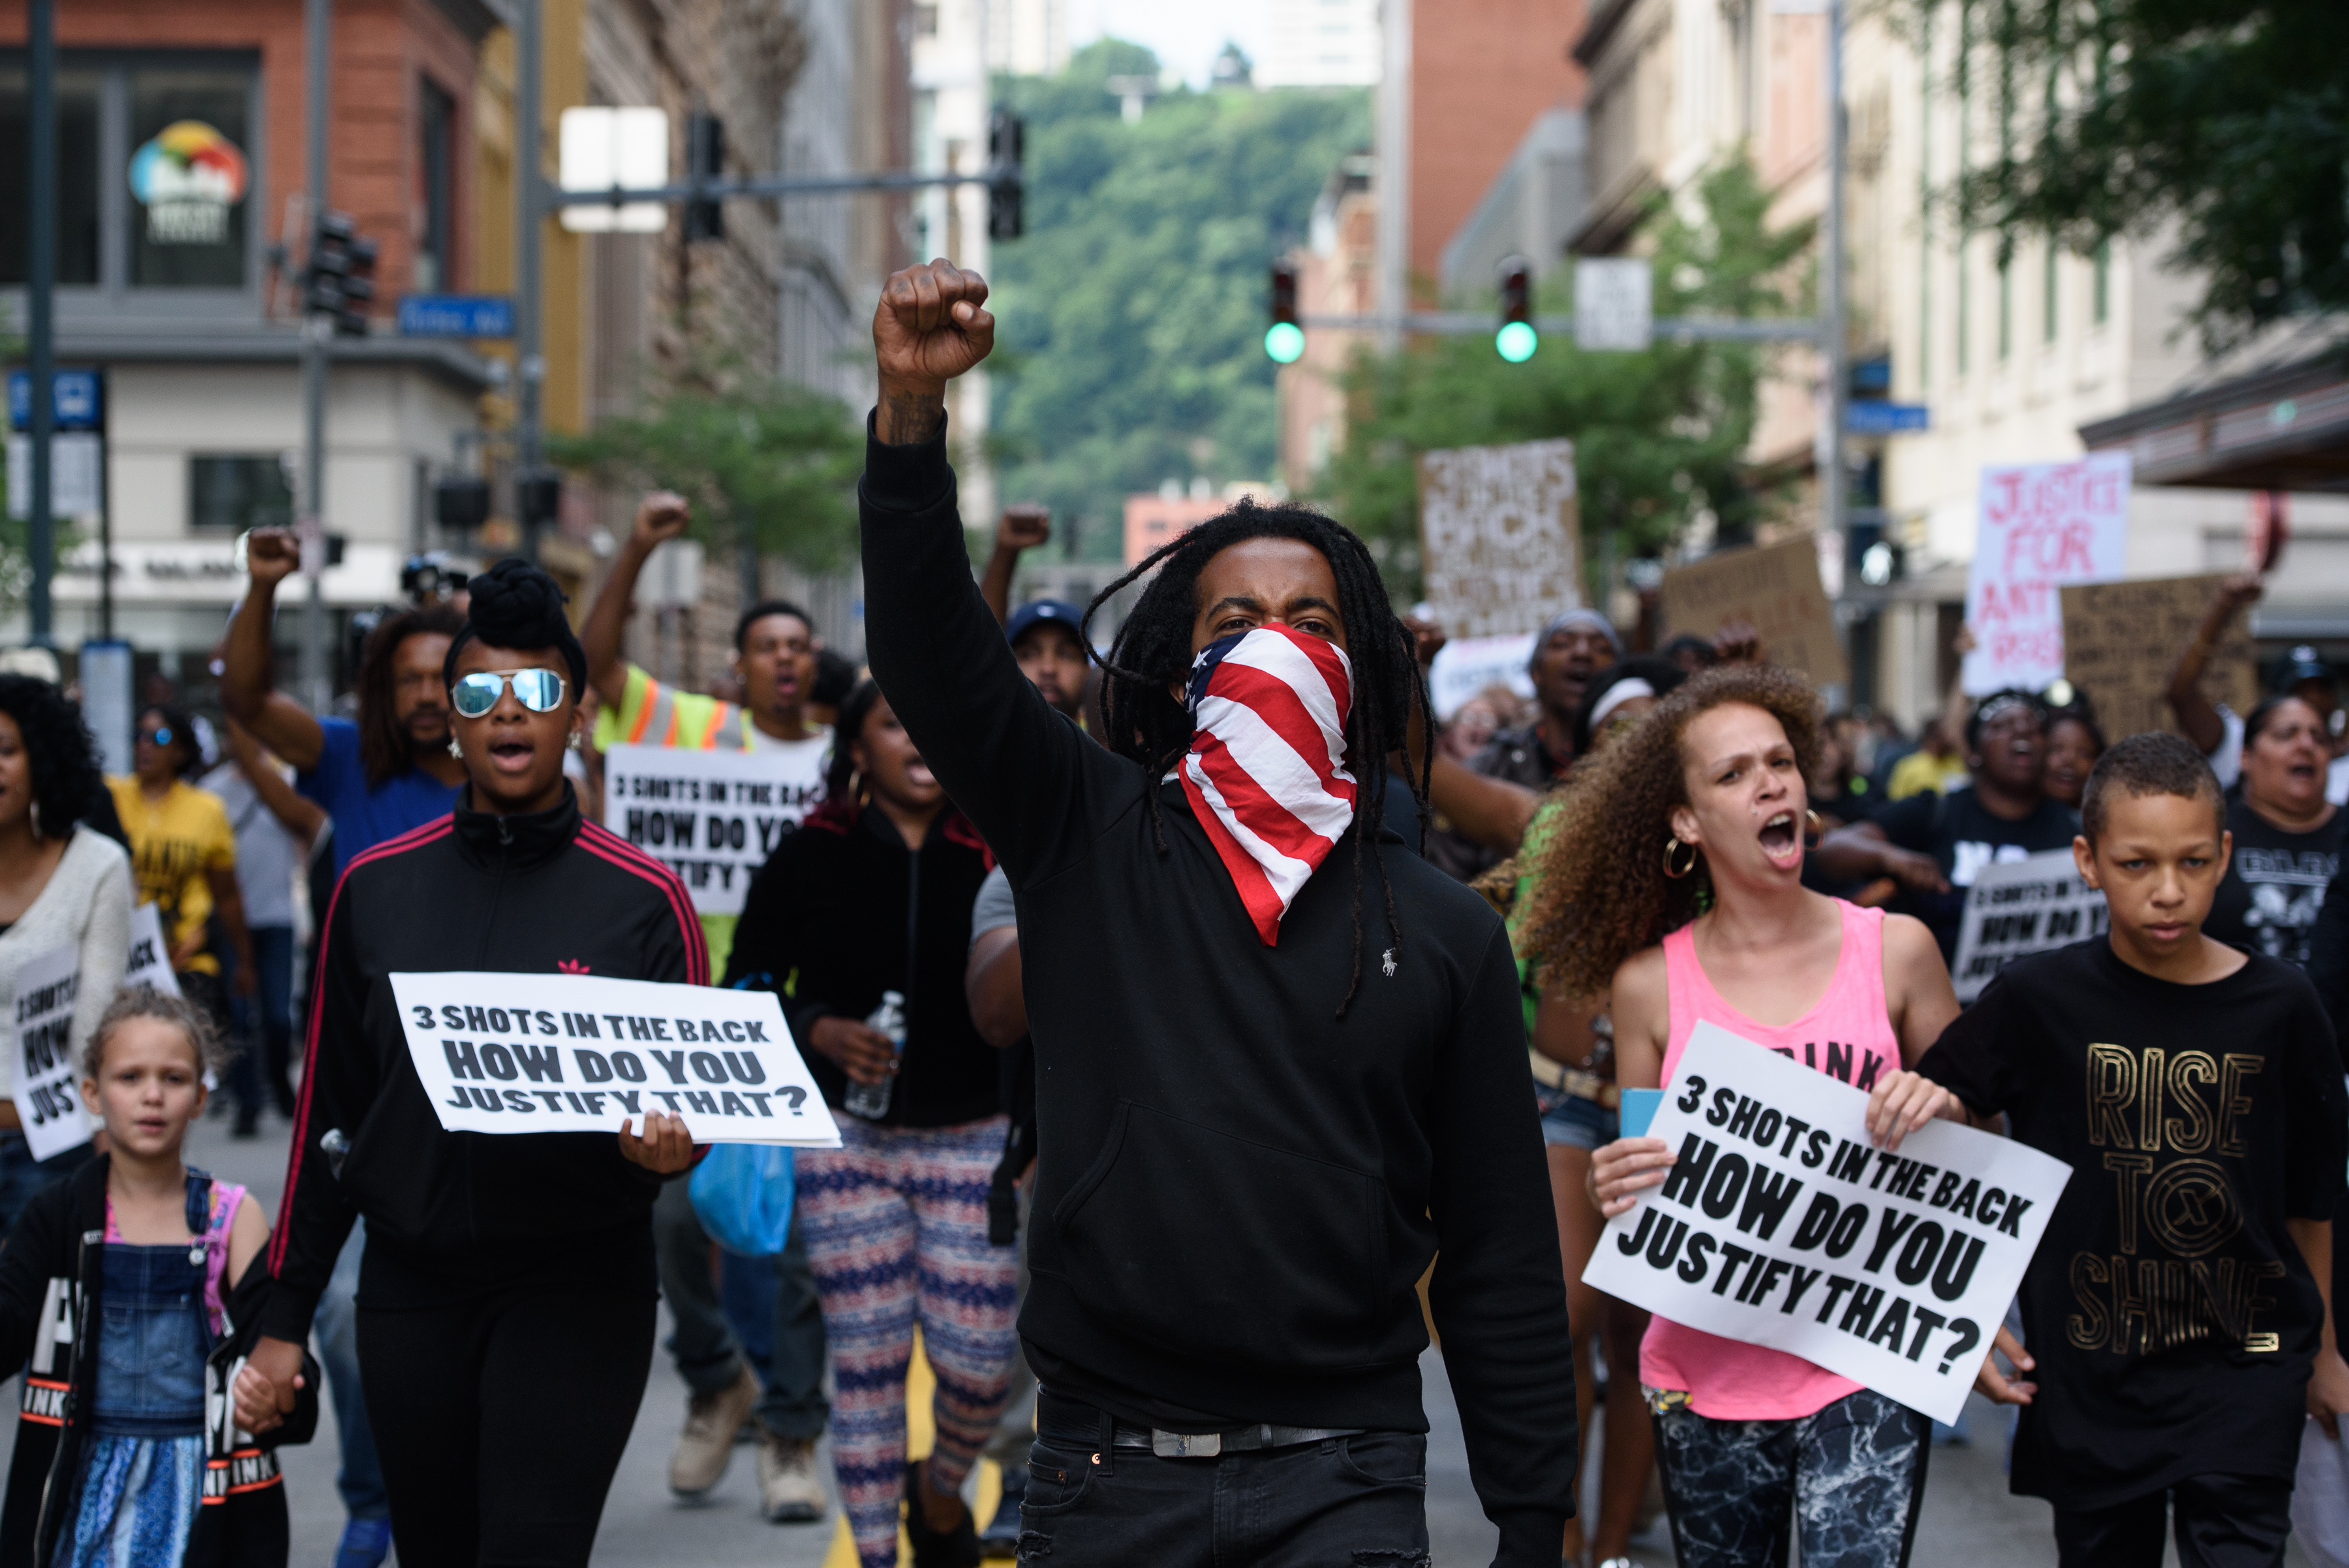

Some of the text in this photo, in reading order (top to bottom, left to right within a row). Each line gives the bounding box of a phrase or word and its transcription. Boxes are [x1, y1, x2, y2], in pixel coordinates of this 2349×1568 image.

[1987, 462, 2121, 523] JUSTICE
[1425, 496, 1566, 550] BACK
[2003, 519, 2095, 576] FOR
[1974, 579, 2057, 622] ANT
[615, 776, 625, 797] 3
[634, 777, 701, 801] SHOTS
[707, 783, 726, 803] IN
[736, 783, 771, 805] THE
[628, 808, 696, 849] HOW
[709, 817, 745, 850] DO
[1980, 912, 2037, 944] HOW
[2046, 910, 2079, 938] DO
[127, 938, 157, 974] ACK
[412, 1005, 773, 1044] 3 SHOTS IN THE BACK
[441, 1039, 767, 1085] HOW DO YOU
[1770, 1042, 1884, 1094] INK
[445, 1085, 808, 1116] JUSTIFY THAT?
[2087, 1043, 2266, 1159] RISE
[1676, 1075, 2033, 1240] 3 SHOTS IN THE BACK
[1661, 1131, 1988, 1302] HOW DO YOU
[1616, 1205, 1982, 1376] JUSTIFY THAT?
[2065, 1250, 2287, 1357] SHINE
